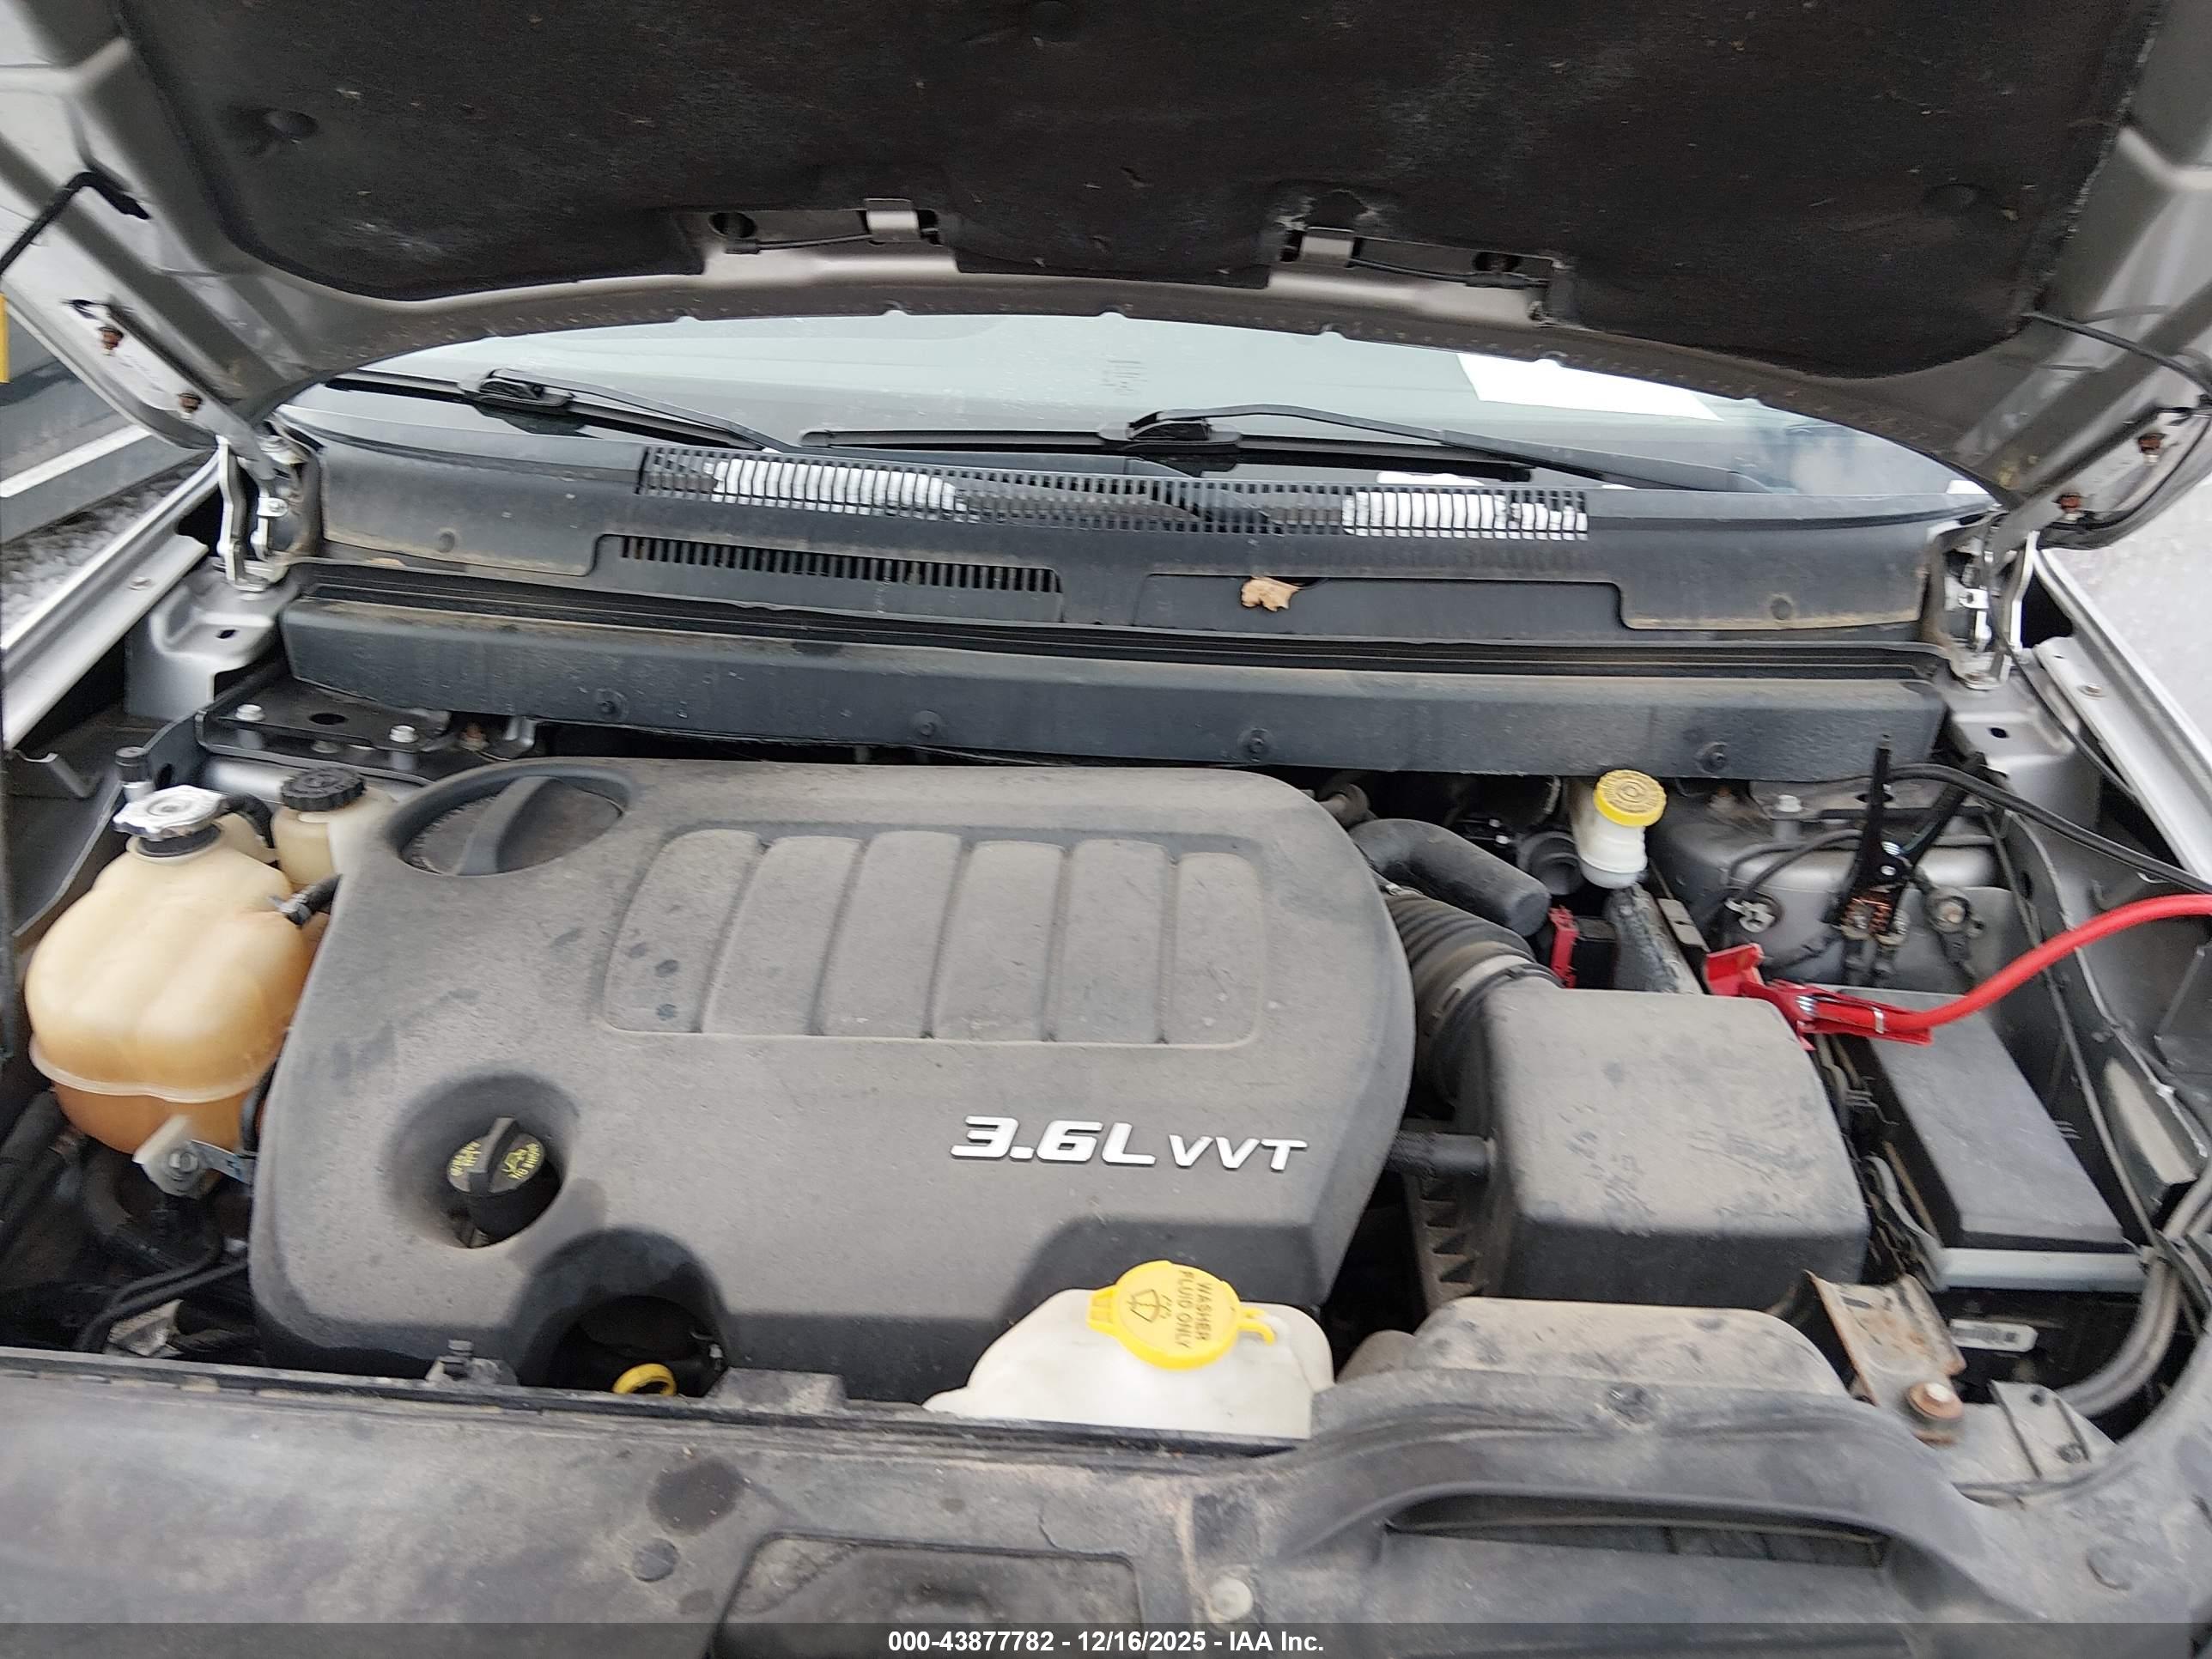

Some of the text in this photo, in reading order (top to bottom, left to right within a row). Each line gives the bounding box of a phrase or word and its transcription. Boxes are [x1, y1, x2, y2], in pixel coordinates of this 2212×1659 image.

[950, 1115, 1308, 1171] 3.6L VVT
[1175, 1269, 1194, 1349] FLUID ONLY
[1195, 1282, 1212, 1340] WASHER
